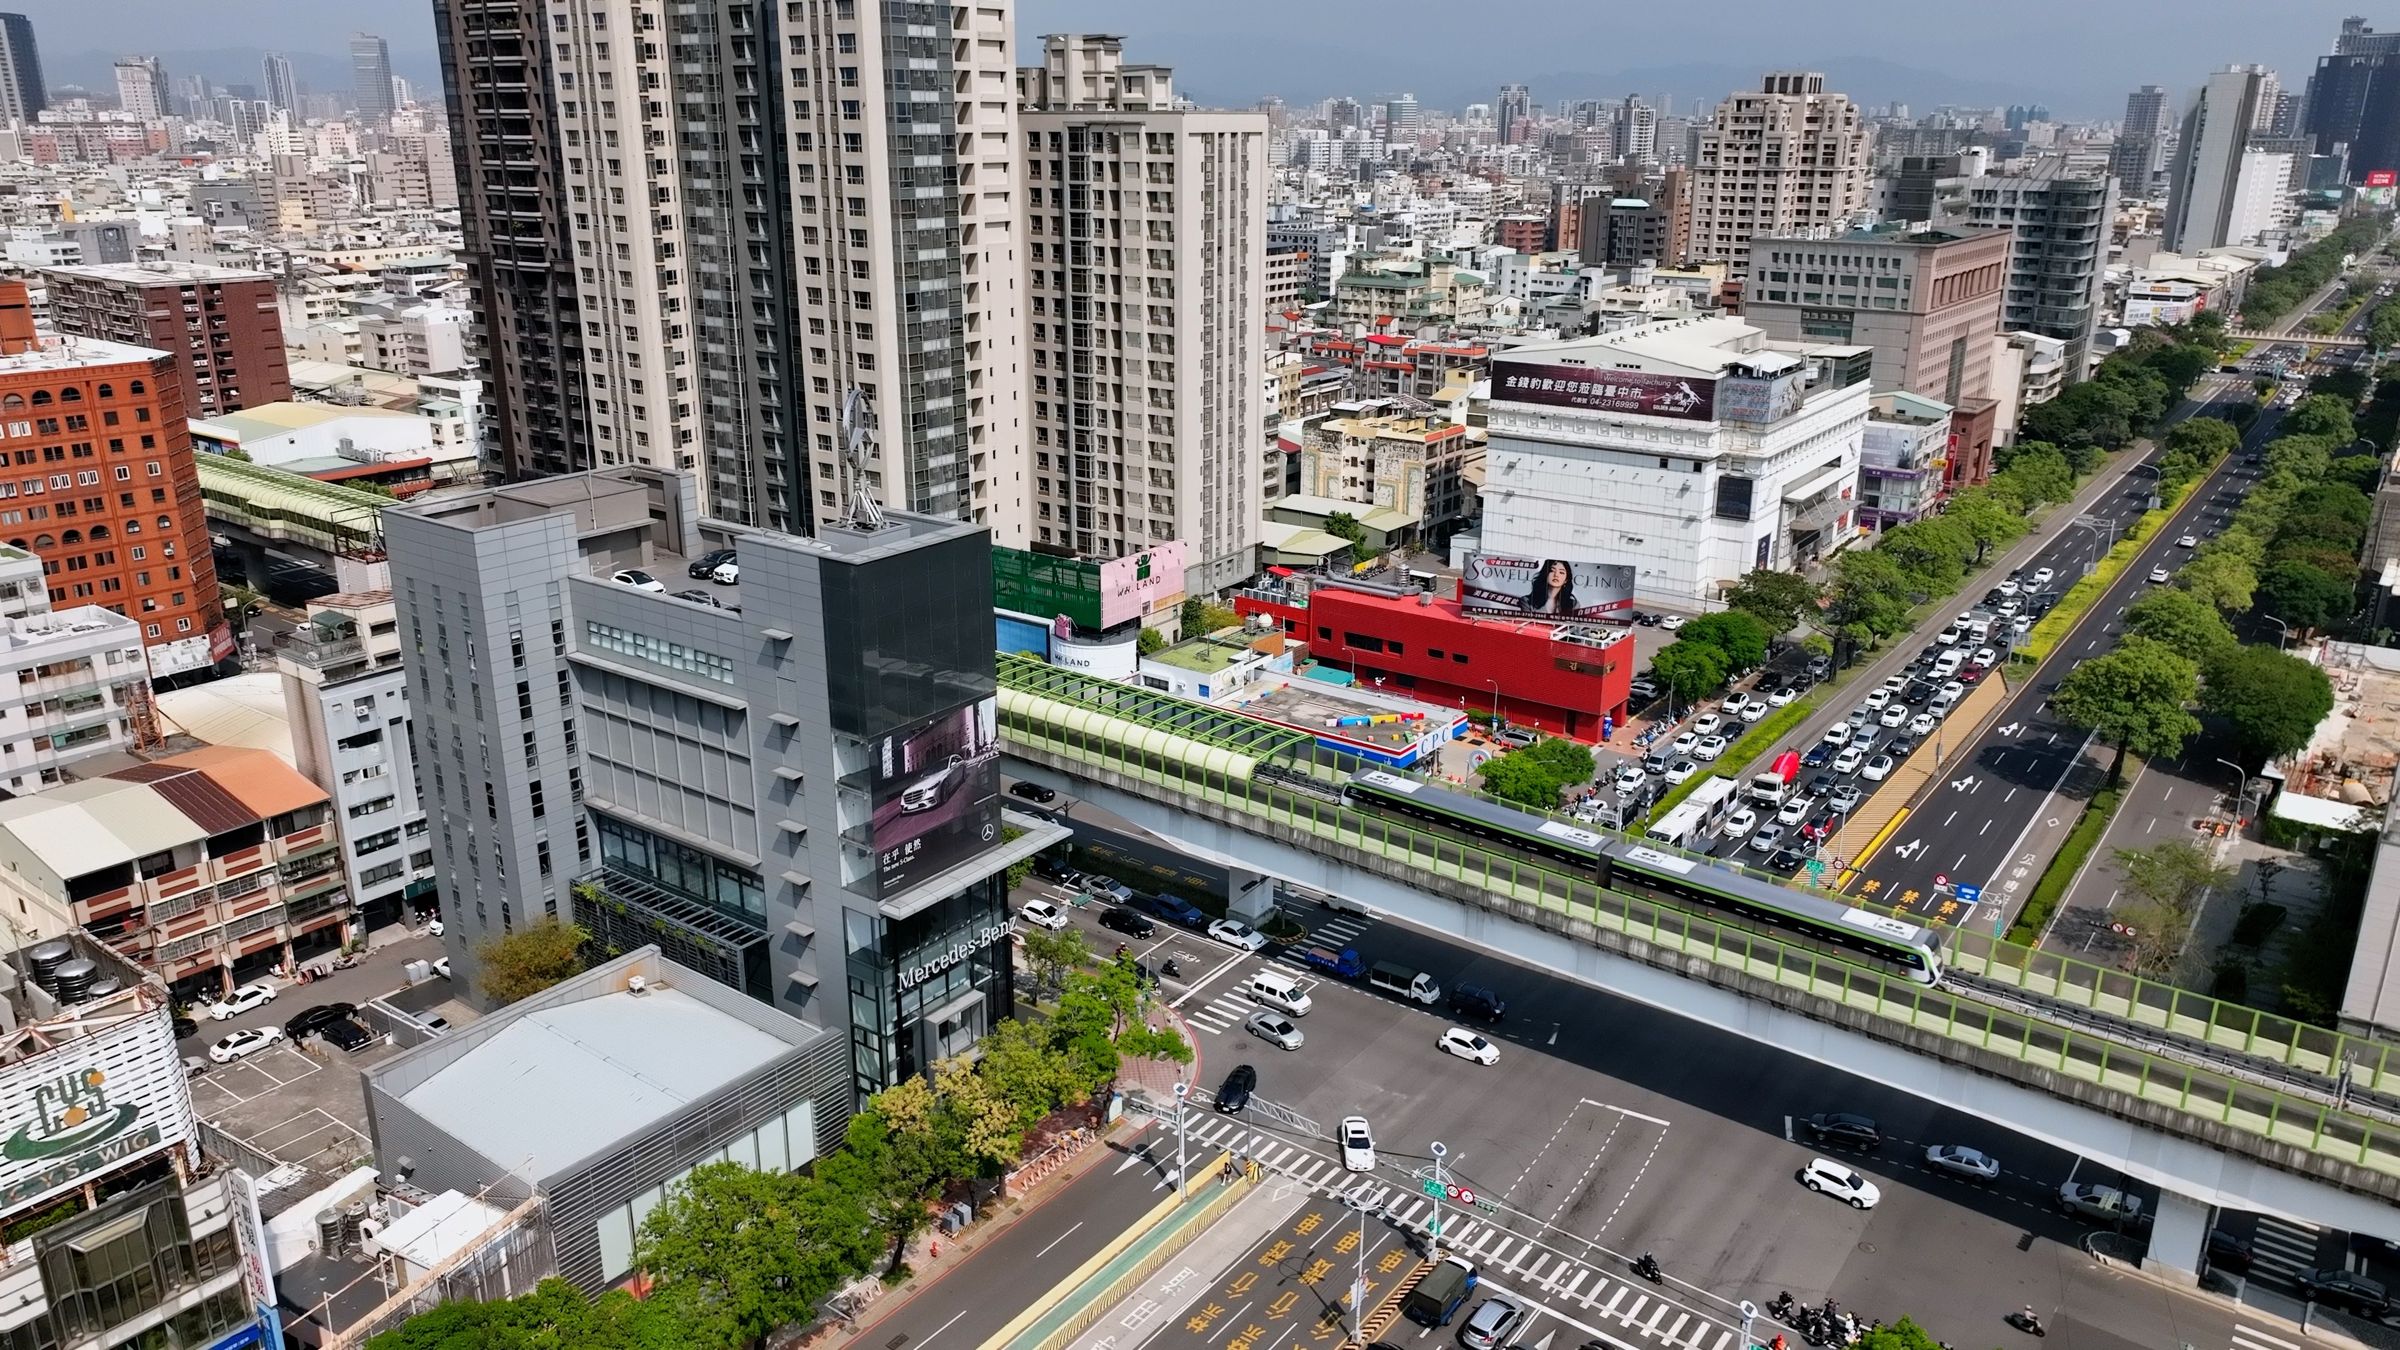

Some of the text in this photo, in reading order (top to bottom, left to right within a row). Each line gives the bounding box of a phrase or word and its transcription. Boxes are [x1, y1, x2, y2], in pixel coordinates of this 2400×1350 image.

[1505, 375, 1643, 399] 金錢豹歡迎您蒞臨臺中市
[1603, 374, 1632, 384] Welcome
[1642, 377, 1672, 389] Taichung
[1590, 397, 1639, 410] 04-23169999
[1465, 559, 1532, 582] SOWELL
[1574, 573, 1632, 590] CLINIC
[1421, 727, 1449, 755] CPC
[897, 916, 1018, 993] Mercedes-Benz
[97, 1132, 150, 1163] WIG
